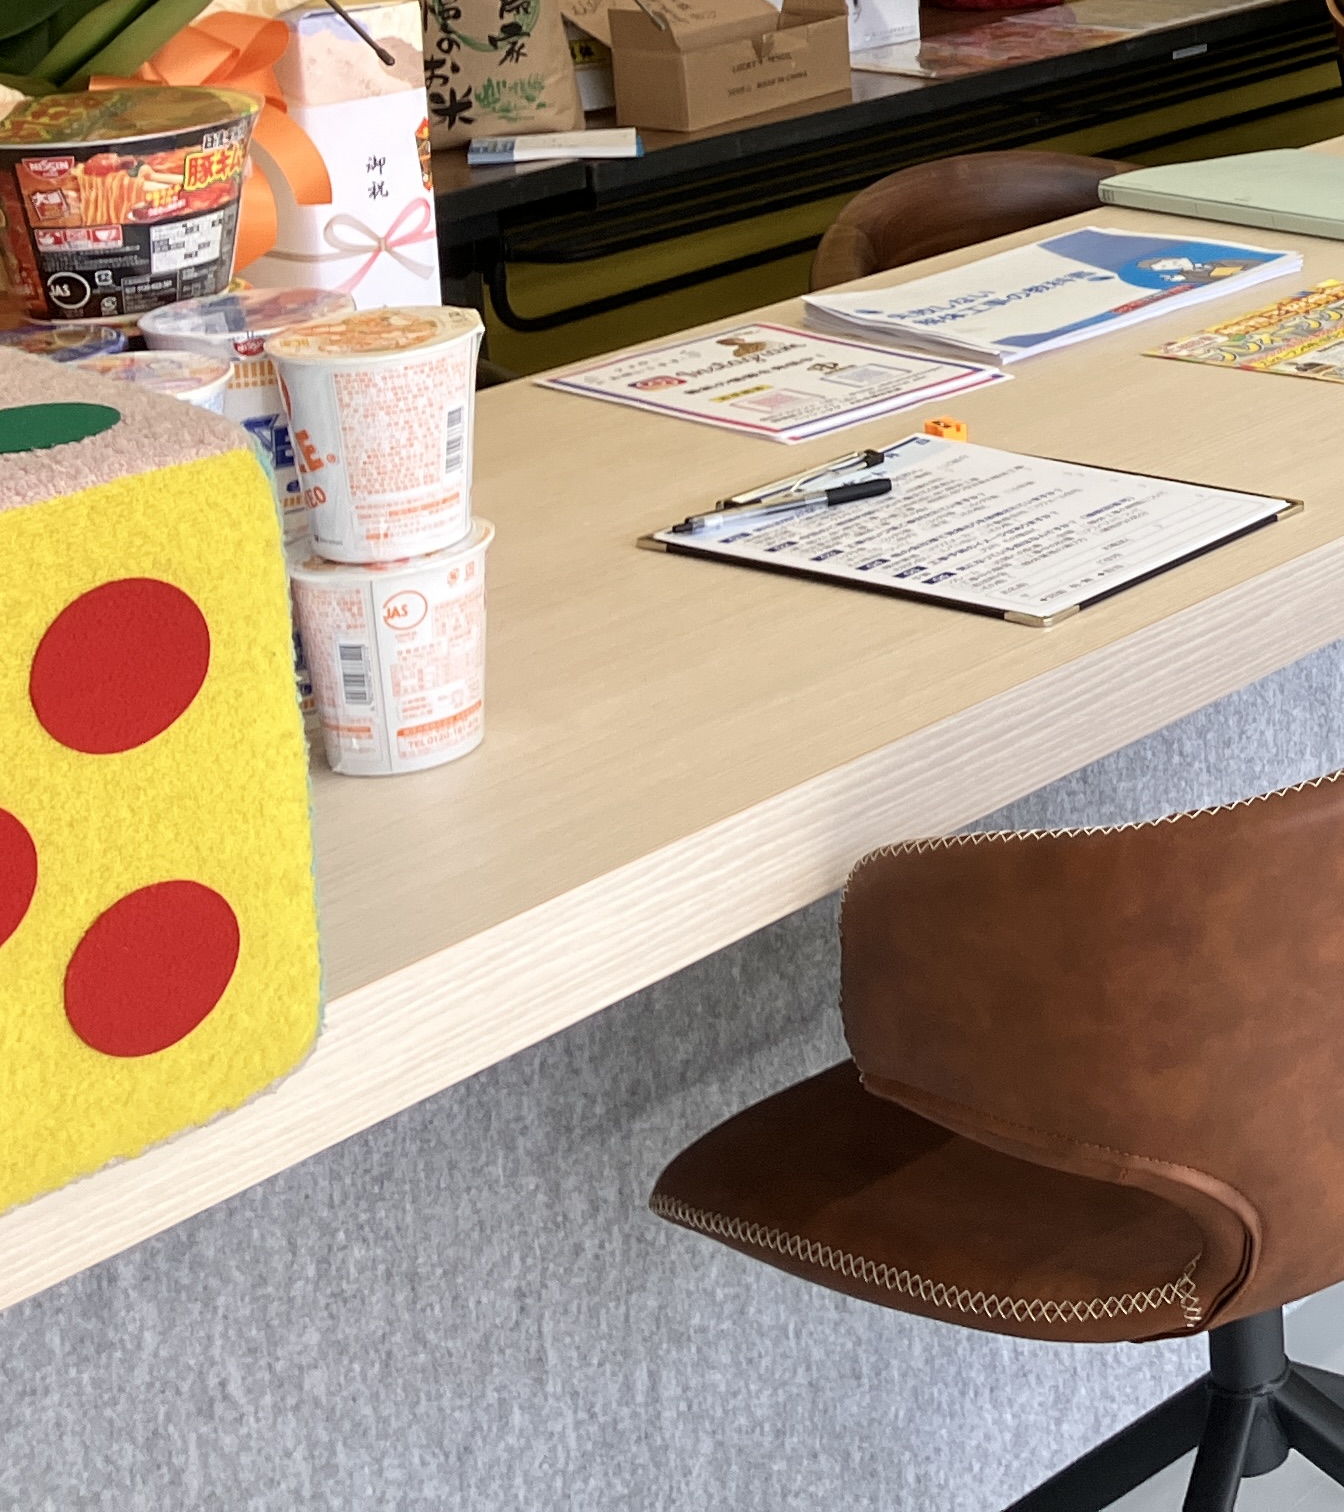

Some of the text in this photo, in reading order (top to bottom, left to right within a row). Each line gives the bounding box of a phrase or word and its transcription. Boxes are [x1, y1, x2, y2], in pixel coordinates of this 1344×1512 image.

[28, 160, 70, 172] NISSIN
[49, 282, 70, 297] JAS
[386, 604, 408, 619] JAS
